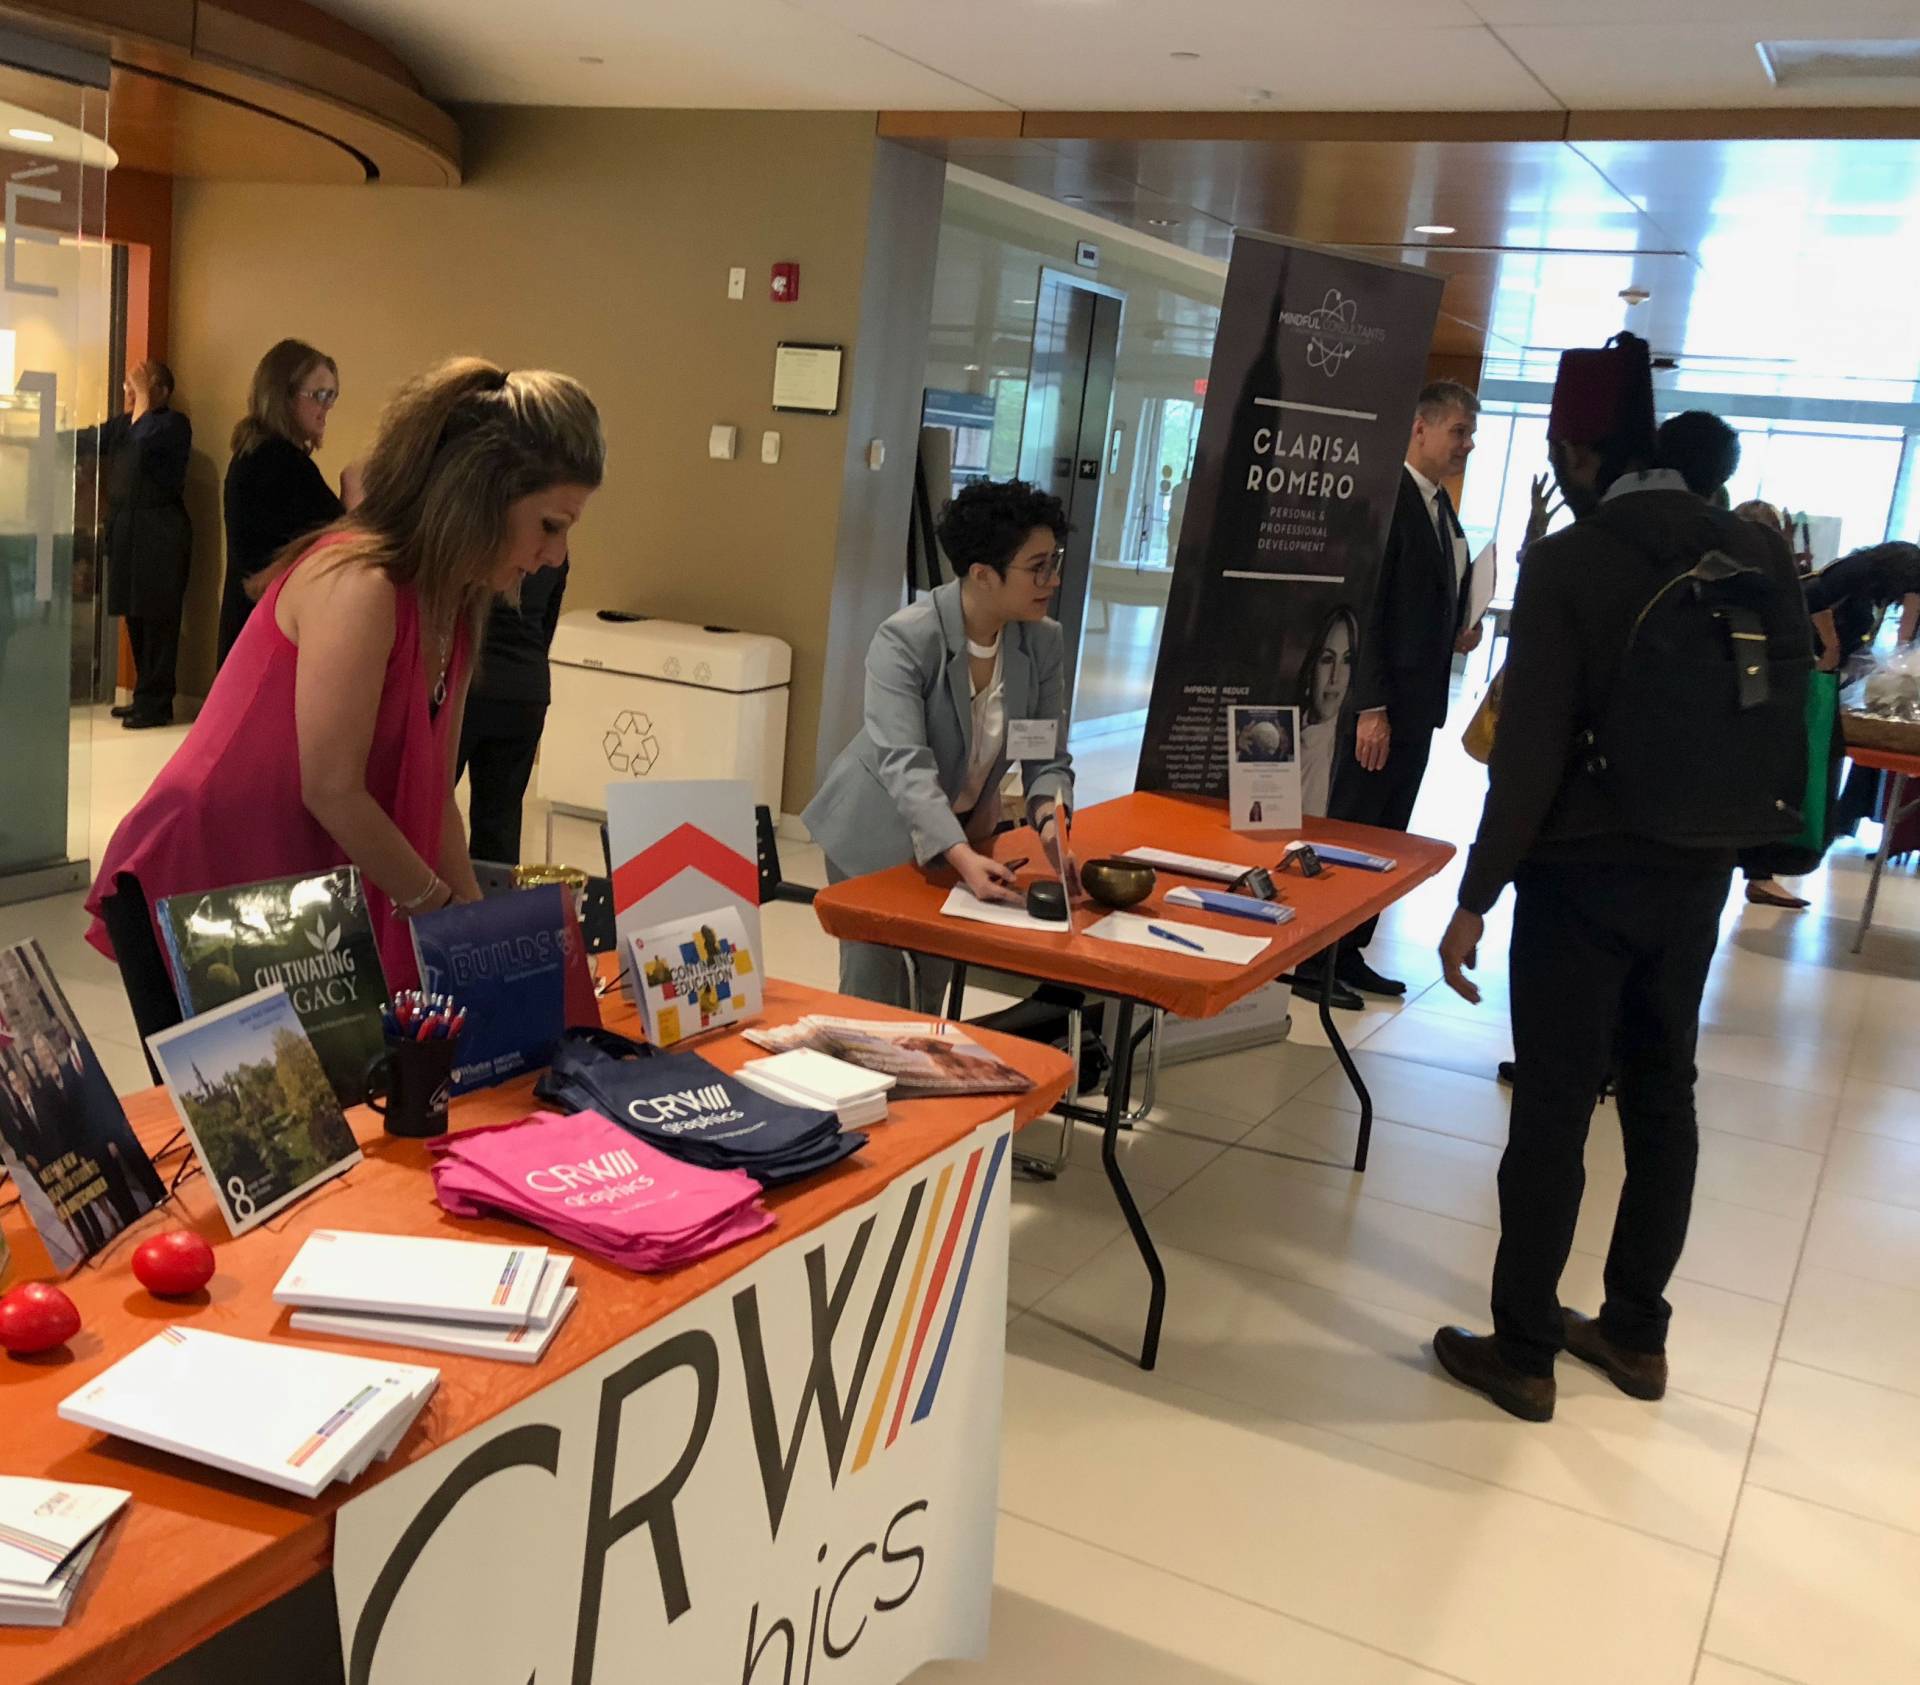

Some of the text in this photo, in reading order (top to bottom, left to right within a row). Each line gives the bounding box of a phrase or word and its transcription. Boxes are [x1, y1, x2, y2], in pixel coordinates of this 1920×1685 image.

[1279, 311, 1320, 329] MINDFUL
[1253, 428, 1360, 465] CLARISA
[1246, 464, 1354, 500] ROMERO
[1269, 506, 1316, 520] PERSONAL
[1259, 522, 1328, 538] PROFESSIONAL
[1257, 538, 1326, 552] DEVELOPMENT
[1183, 685, 1250, 695] IMPROVE REDUCE
[254, 948, 356, 990] CULTIVATING
[293, 975, 358, 1015] GACY
[674, 969, 733, 998] EDUCATION
